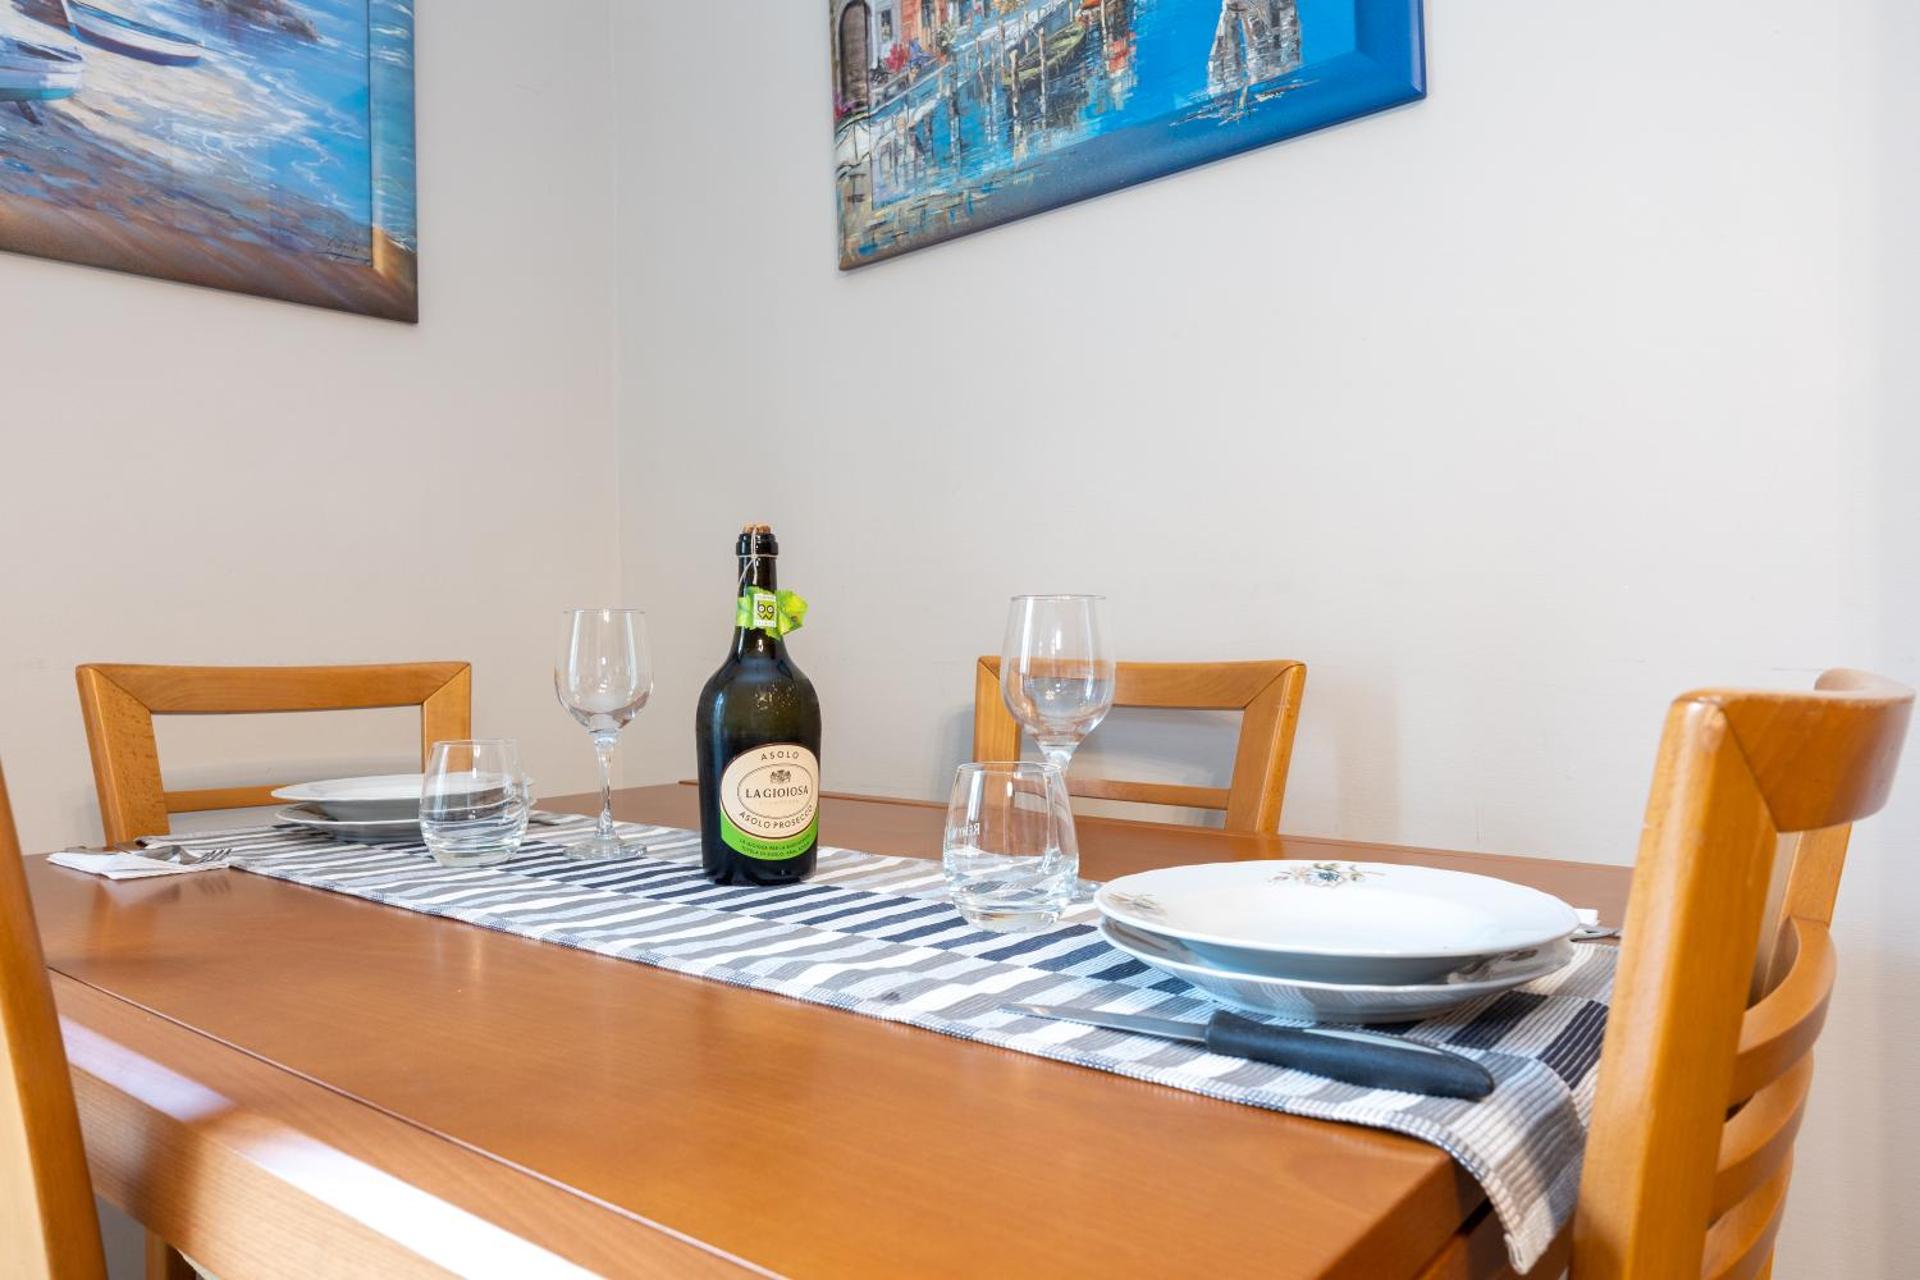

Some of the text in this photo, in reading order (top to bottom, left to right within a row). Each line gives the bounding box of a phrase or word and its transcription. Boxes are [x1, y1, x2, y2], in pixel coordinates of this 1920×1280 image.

[761, 750, 800, 761] ASOLO
[745, 785, 809, 799] LA GIOIOSA
[739, 804, 813, 829] ASOLO PROSECCO
